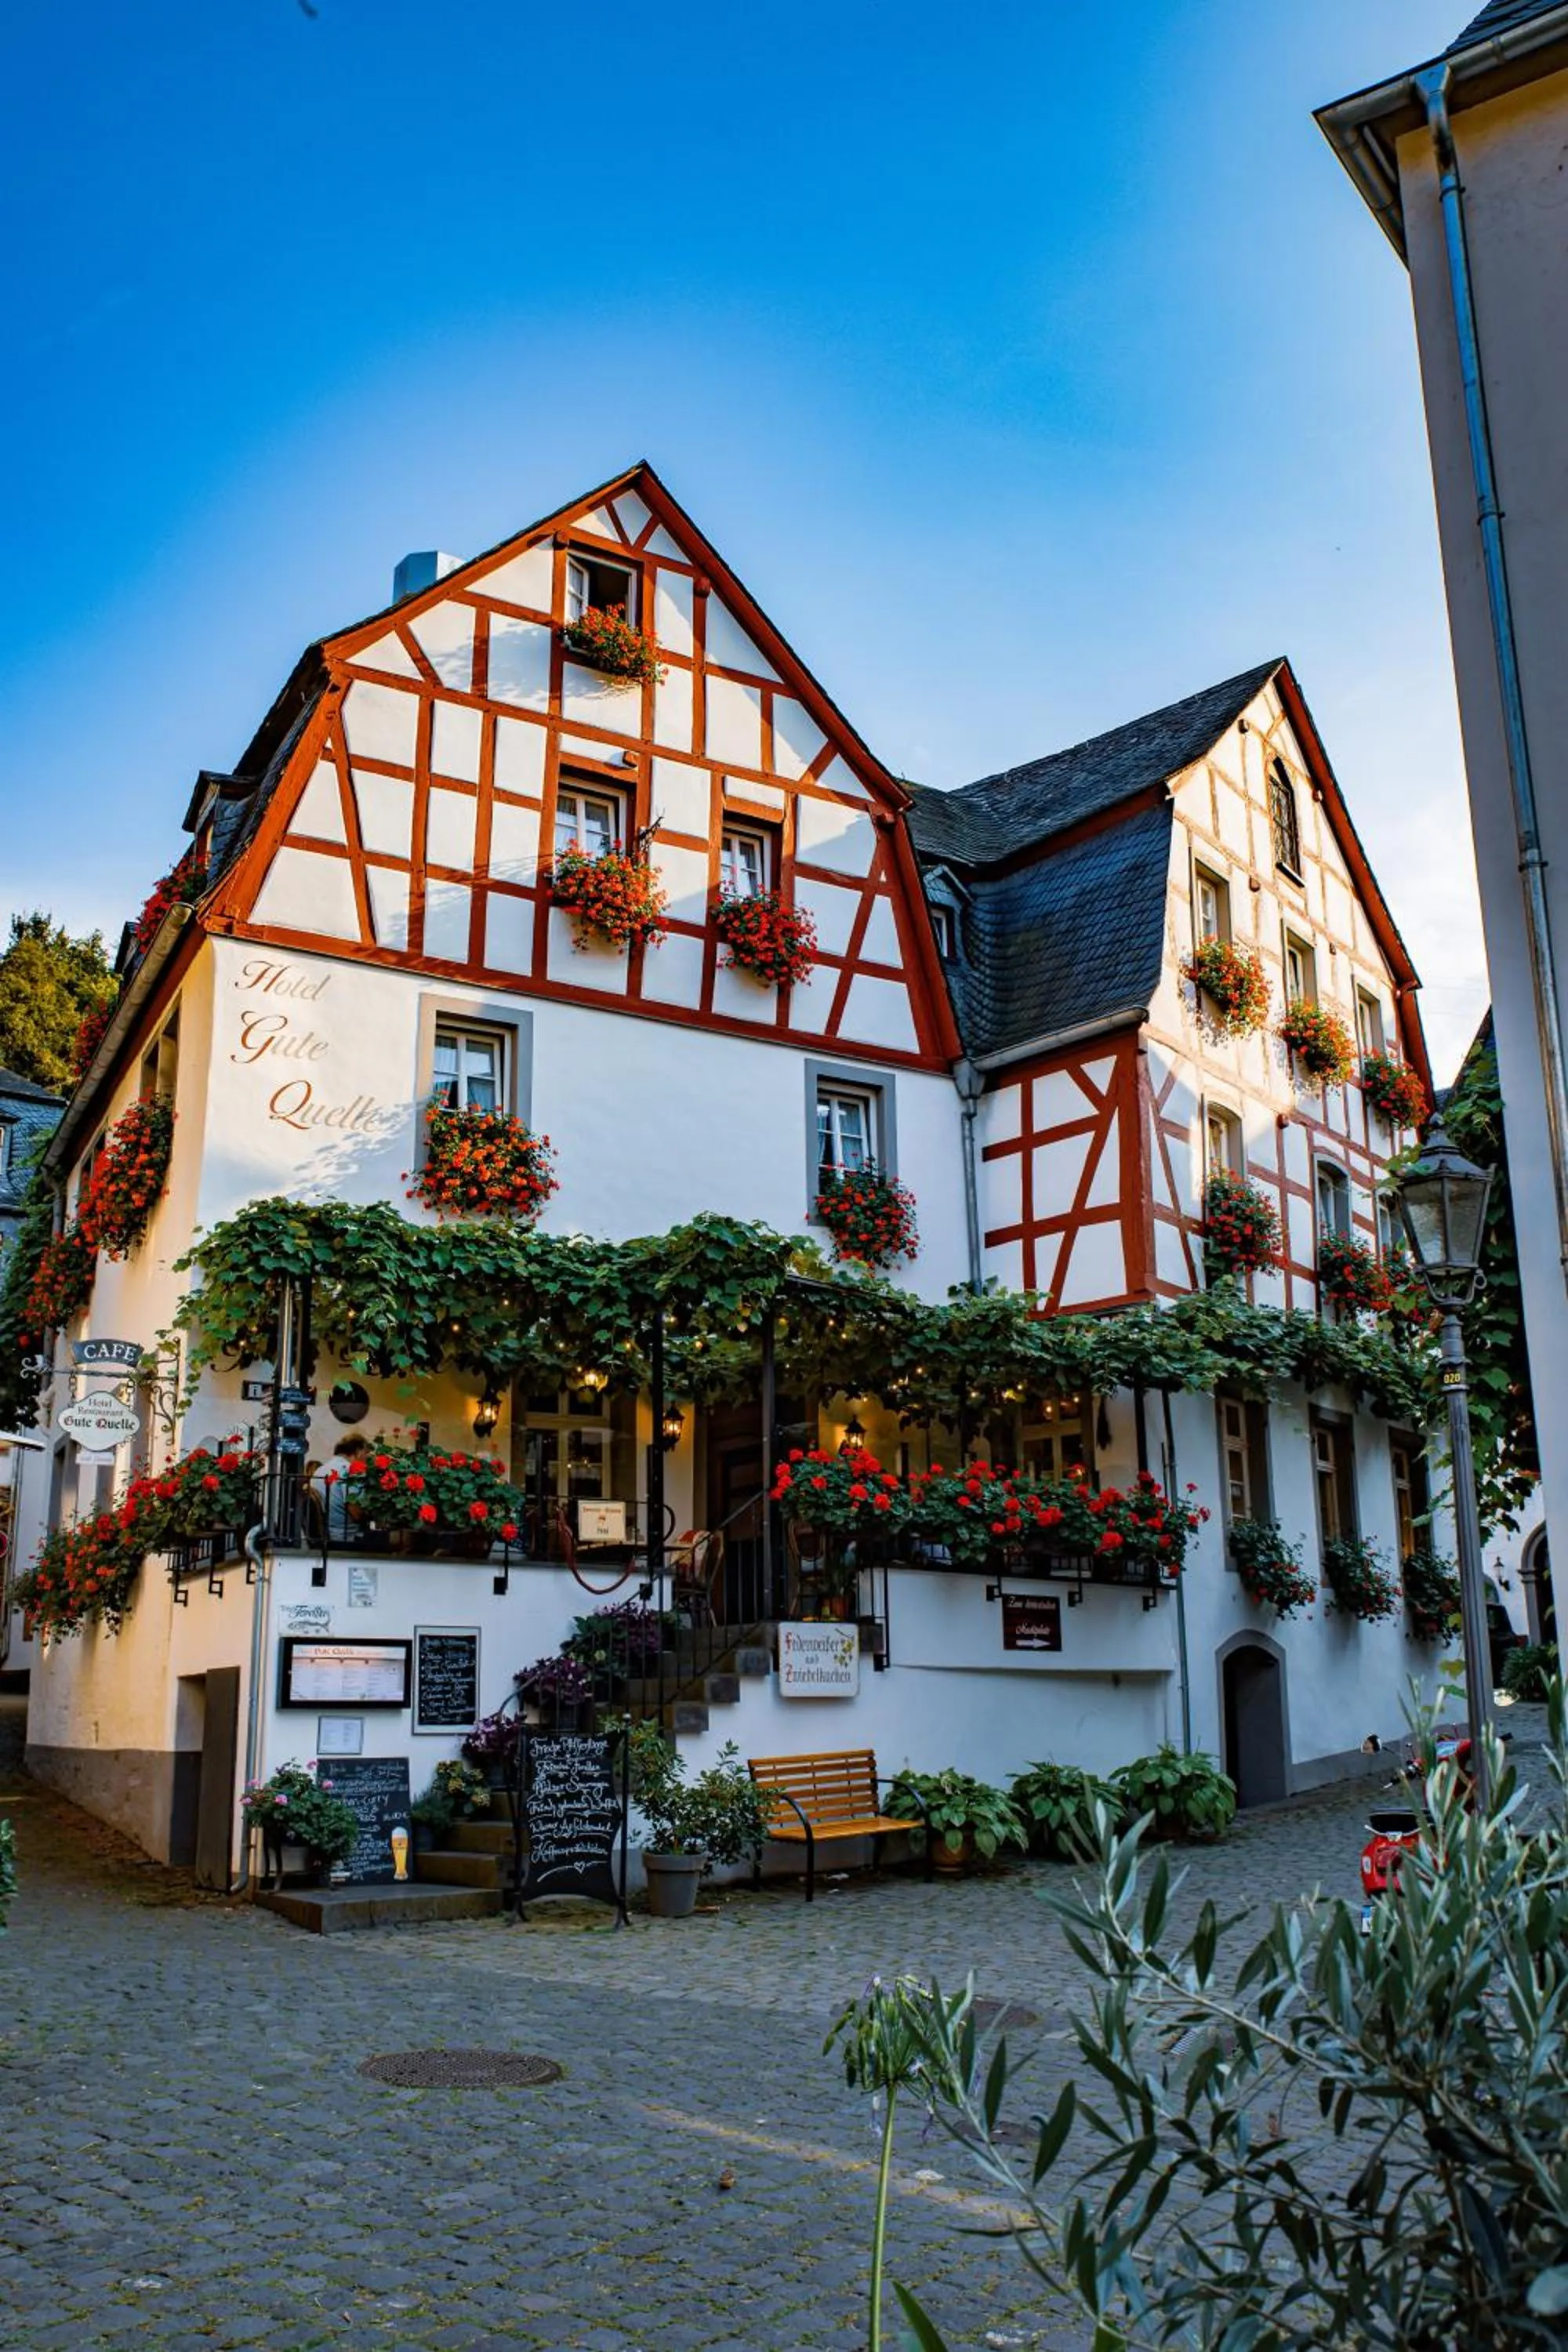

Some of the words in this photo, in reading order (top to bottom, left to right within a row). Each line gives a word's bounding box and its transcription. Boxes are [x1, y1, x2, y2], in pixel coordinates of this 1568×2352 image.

[235, 960, 331, 1002] Hotel
[230, 1011, 329, 1064] Gute
[268, 1080, 384, 1133] Quelle
[83, 1344, 137, 1362] CAFE
[89, 1398, 113, 1408] Hotel
[64, 1415, 92, 1428] Gute
[96, 1417, 136, 1431] Quelle
